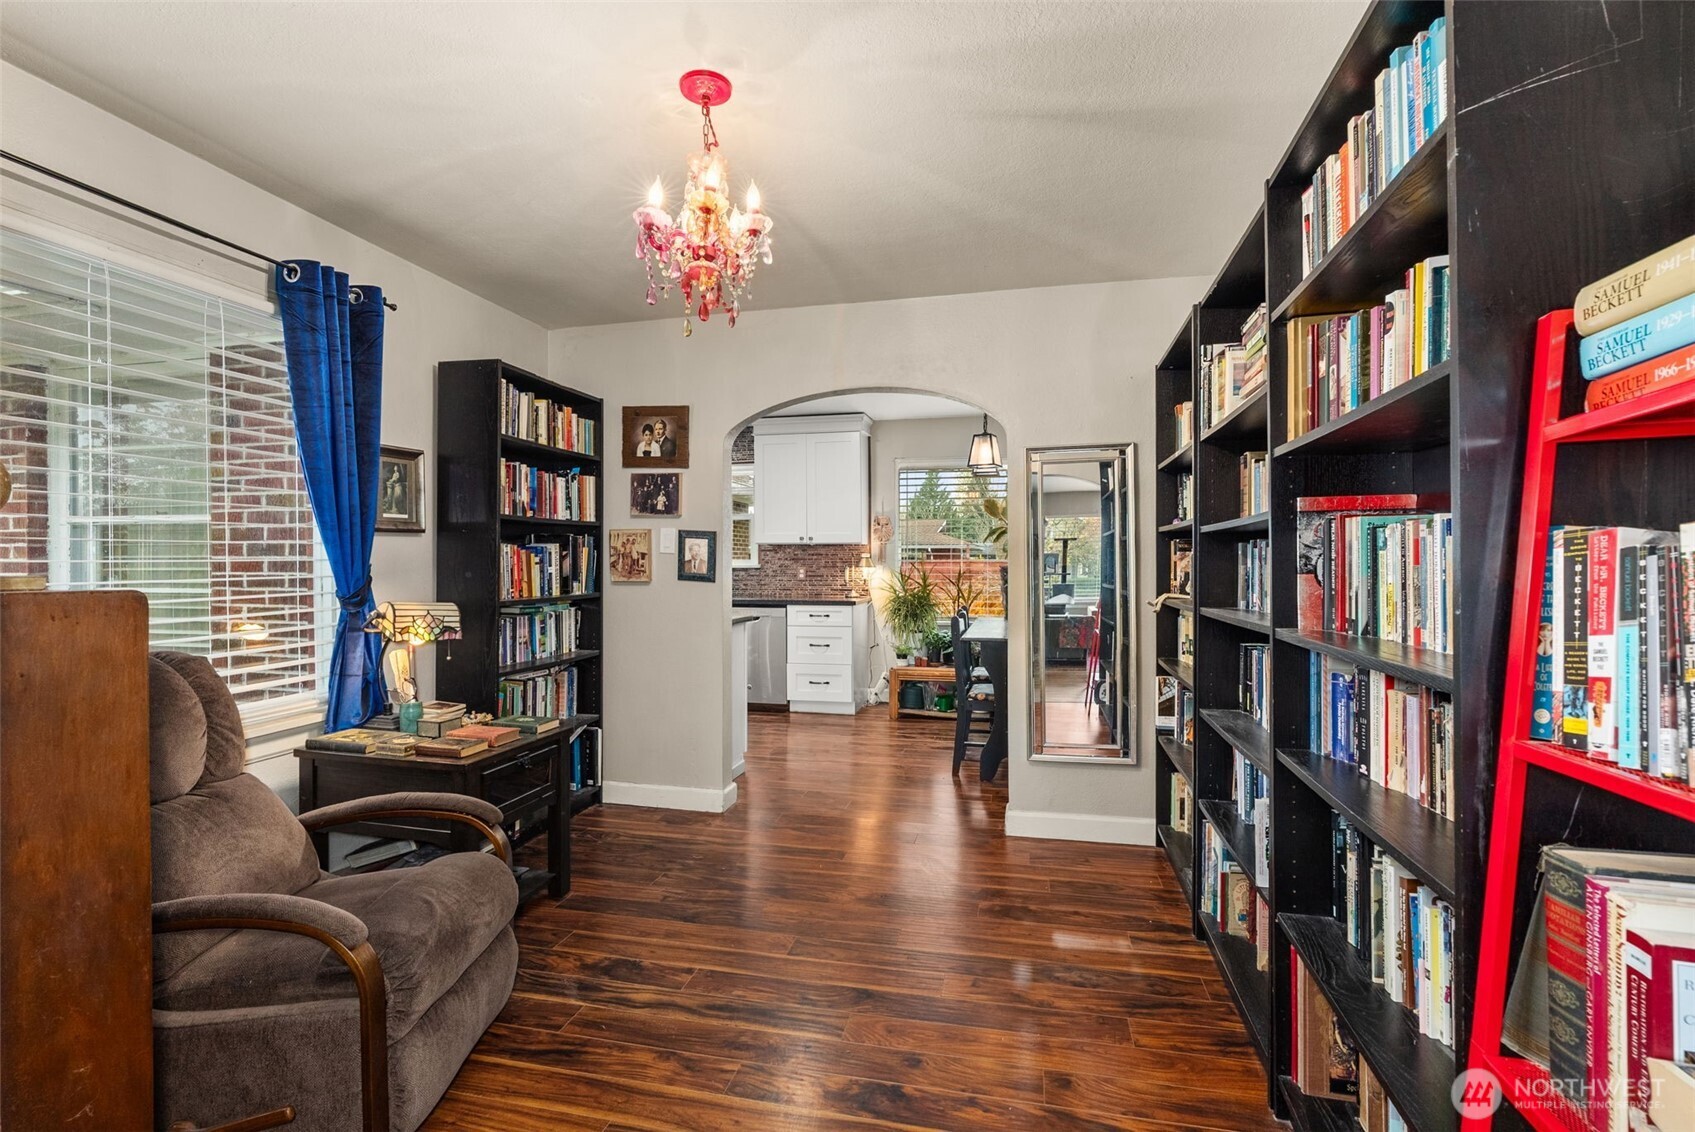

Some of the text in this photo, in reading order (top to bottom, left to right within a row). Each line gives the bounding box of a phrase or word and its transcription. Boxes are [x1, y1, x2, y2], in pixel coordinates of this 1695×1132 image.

[1582, 283, 1645, 321] BECKETT
[1593, 269, 1652, 304] SAMUEL
[1587, 338, 1647, 371] BECKETT
[1597, 323, 1653, 356] SAMUEL
[1600, 372, 1651, 400] SAMUEL
[1600, 535, 1609, 561] DEAR
[1574, 564, 1582, 639] BECKETT
[1599, 586, 1607, 630] BECKETT
[1639, 560, 1647, 652] BECKETT
[1585, 883, 1593, 920] ALLEN
[1593, 889, 1601, 903] The
[1593, 904, 1601, 937] Selected
[1630, 974, 1639, 1018] CENTURY
